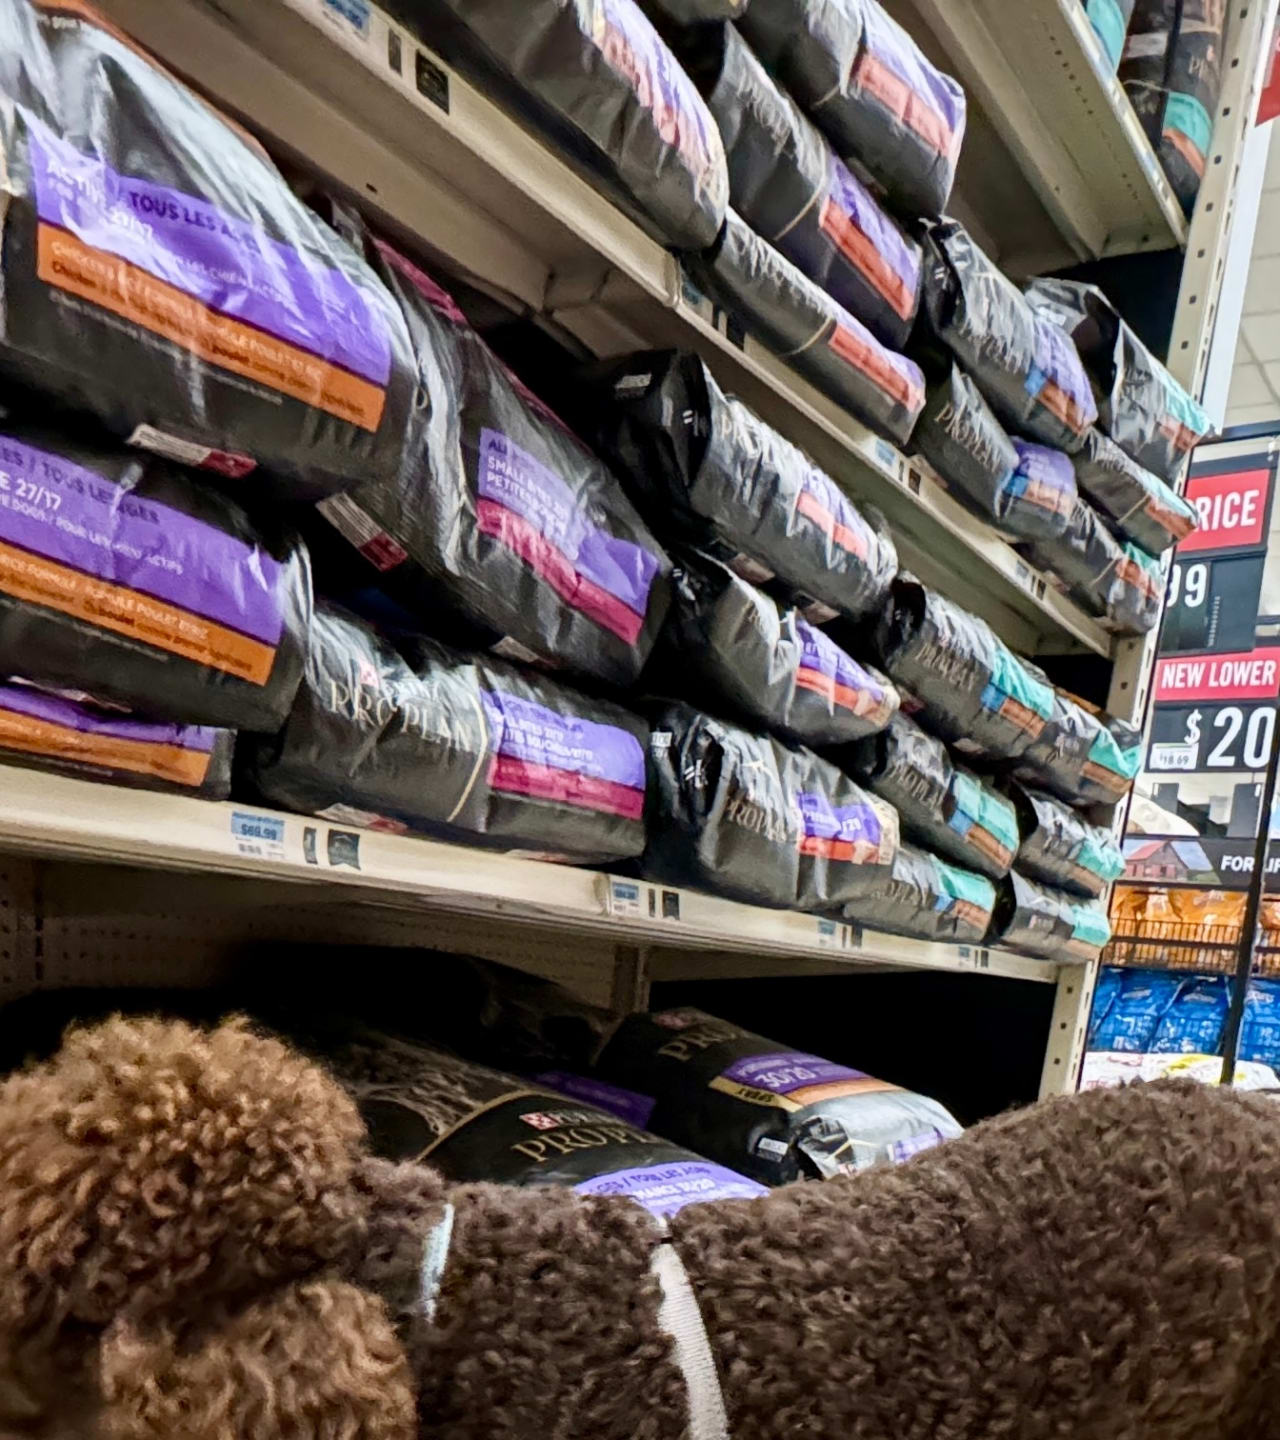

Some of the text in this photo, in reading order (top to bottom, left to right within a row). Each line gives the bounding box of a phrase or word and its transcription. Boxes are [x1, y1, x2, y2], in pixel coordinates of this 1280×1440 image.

[128, 191, 216, 231] TOUS LES
[15, 478, 63, 511] 27/17
[1188, 488, 1261, 533] RICE
[1161, 661, 1206, 690] NEW
[1208, 659, 1276, 688] LOWER
[1220, 854, 1256, 872] FOR
[511, 1125, 609, 1164] PRO
